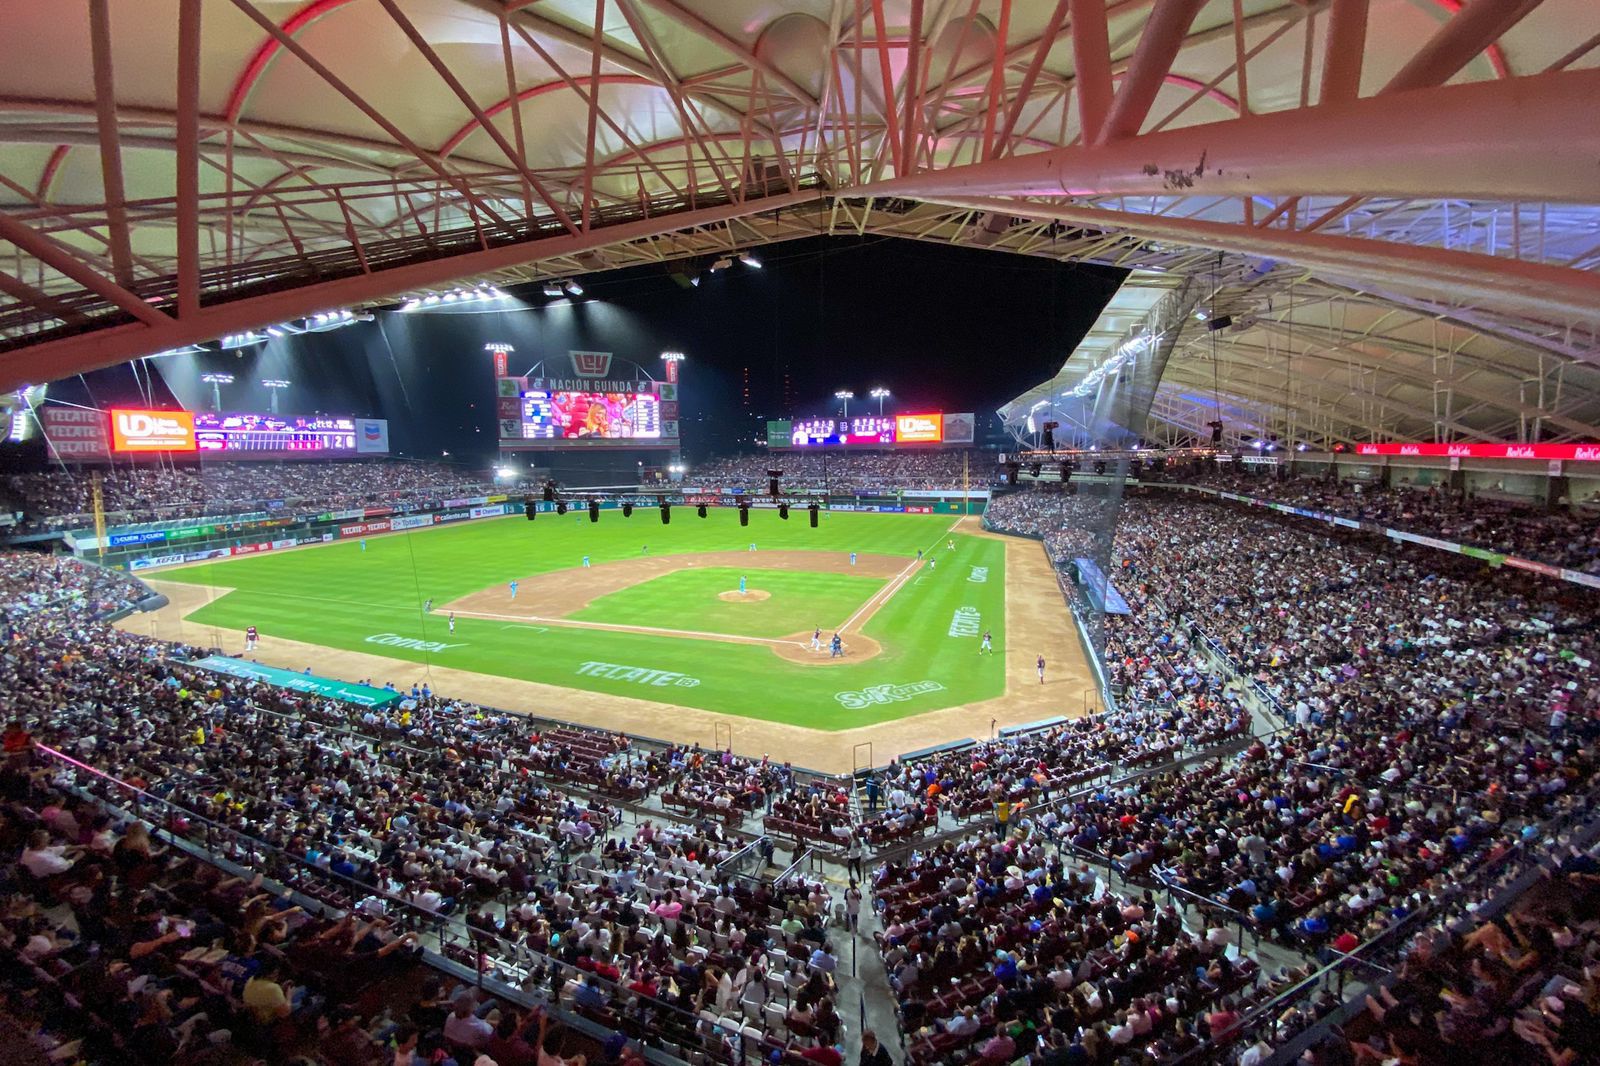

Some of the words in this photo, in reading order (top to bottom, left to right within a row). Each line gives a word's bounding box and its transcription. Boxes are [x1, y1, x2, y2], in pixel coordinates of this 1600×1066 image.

[594, 380, 633, 392] GUINDA
[575, 660, 691, 686] TECATE
[834, 679, 946, 710] SuKarne
